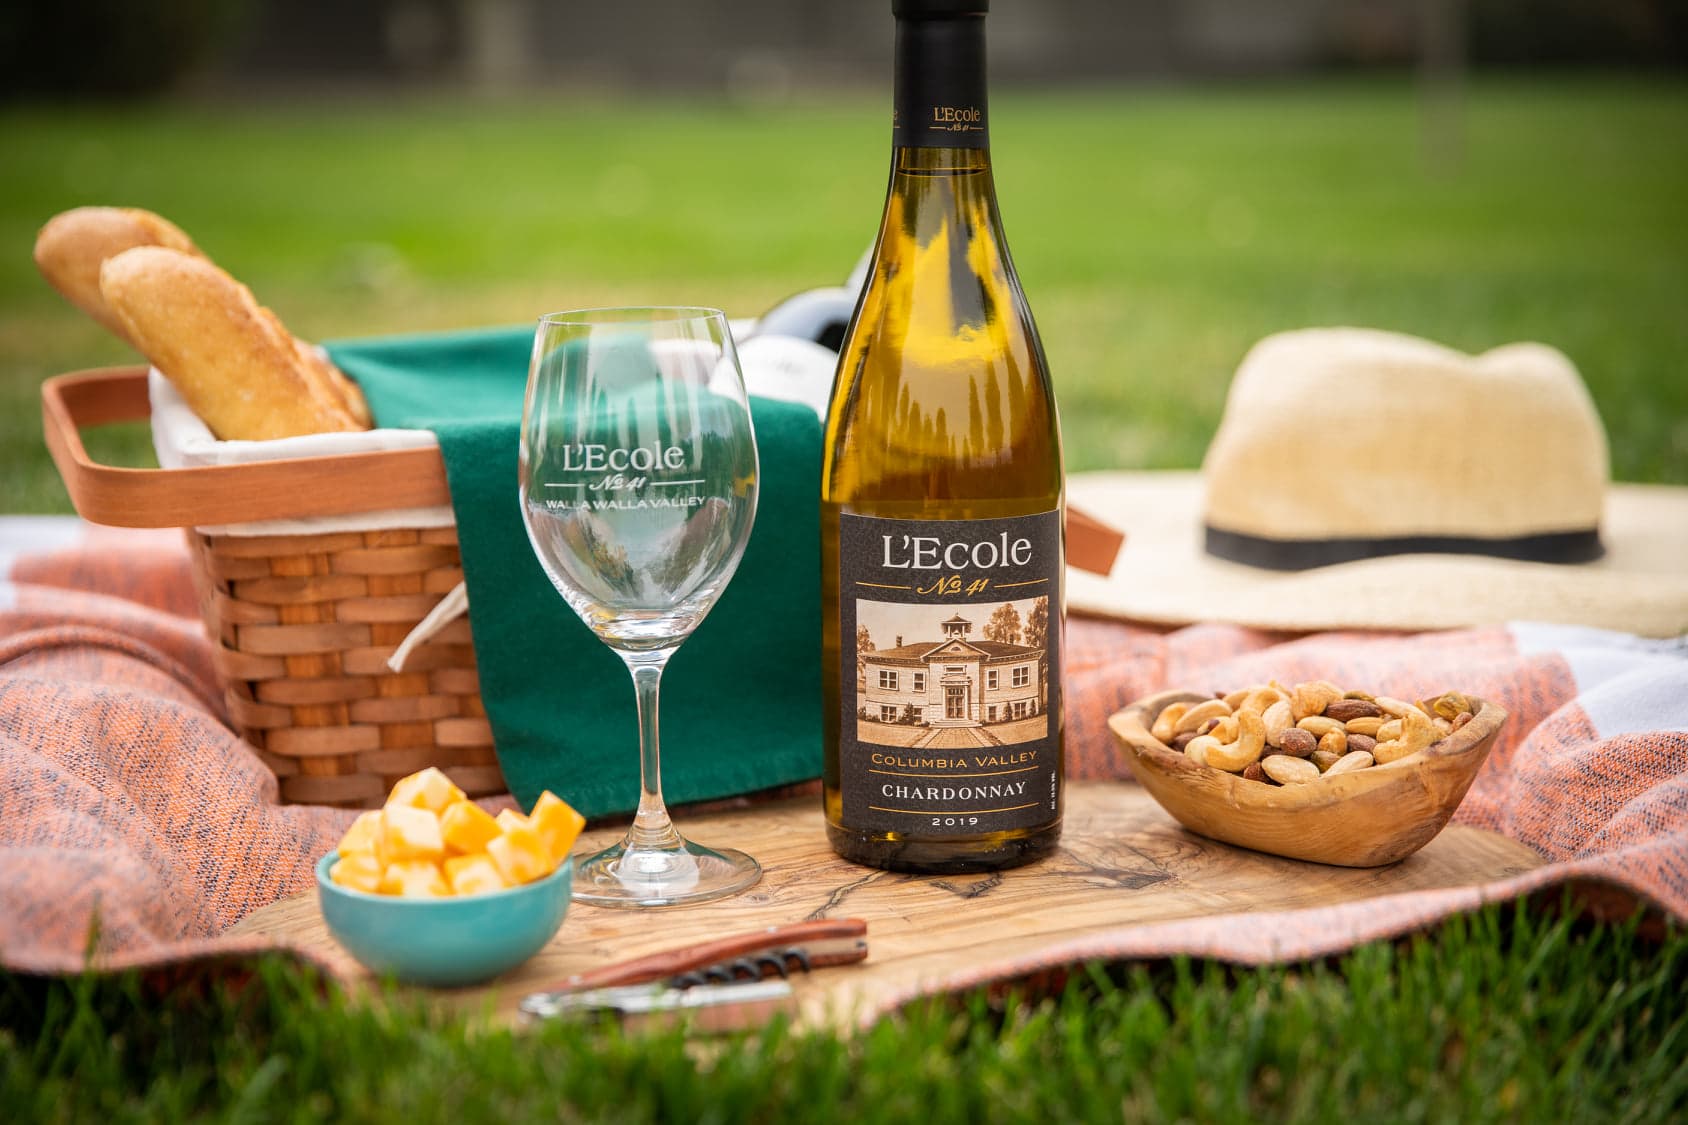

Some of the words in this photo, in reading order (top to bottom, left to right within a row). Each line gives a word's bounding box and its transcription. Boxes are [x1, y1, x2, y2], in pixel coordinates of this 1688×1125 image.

[934, 107, 981, 121] L'Ecole
[563, 440, 685, 471] L'Ecole
[593, 500, 649, 510] WALLA
[649, 496, 705, 508] VALLEY
[882, 533, 1032, 569] L'Ecole
[964, 578, 989, 596] 41
[882, 782, 1025, 800] CHARDONNAY
[932, 817, 978, 826] 2019
